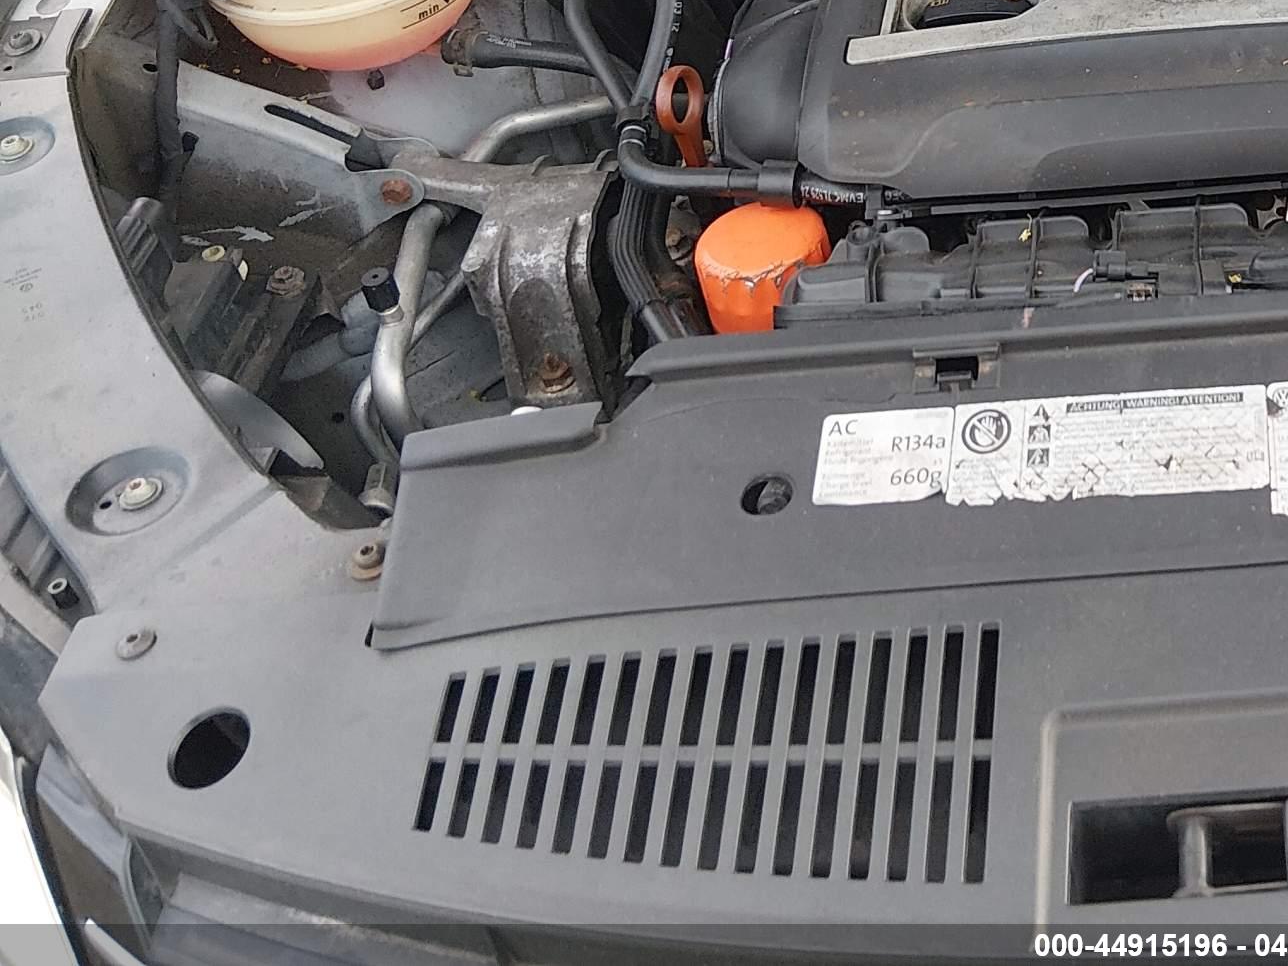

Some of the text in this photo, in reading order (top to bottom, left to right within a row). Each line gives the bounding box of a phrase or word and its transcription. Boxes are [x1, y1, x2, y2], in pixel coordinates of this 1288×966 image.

[418, 3, 439, 20] min
[1070, 393, 1241, 412] ACHTUNG! WARNING! ATTENTION!
[892, 435, 946, 452] R134a
[890, 467, 942, 489] 660g
